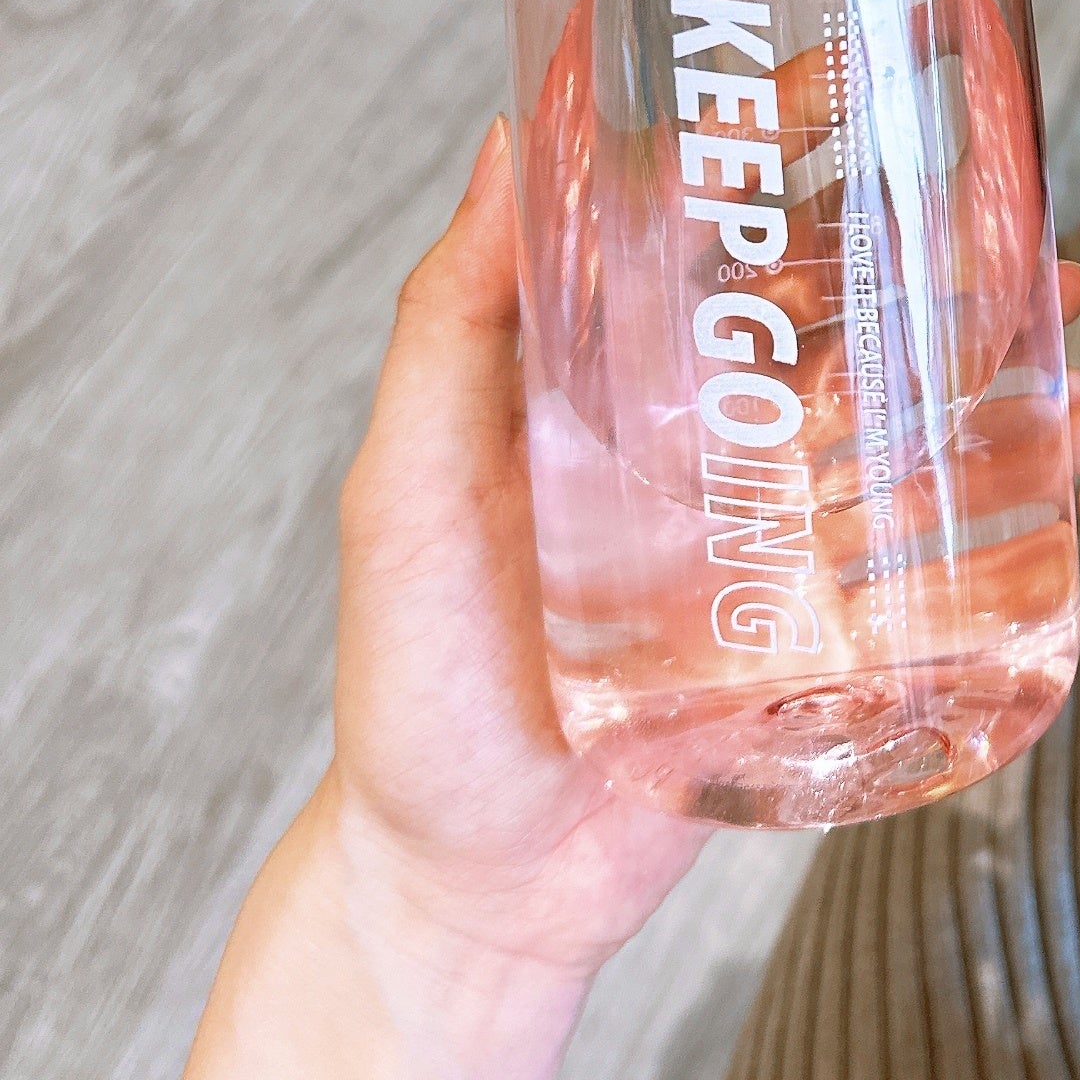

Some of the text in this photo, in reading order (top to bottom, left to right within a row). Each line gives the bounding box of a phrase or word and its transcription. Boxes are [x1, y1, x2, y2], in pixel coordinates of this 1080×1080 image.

[848, 223, 875, 280] LOVE
[854, 284, 878, 305] IT
[856, 308, 886, 403] BECAUSE
[692, 291, 823, 655] GOING
[866, 451, 895, 529] YOUNG
